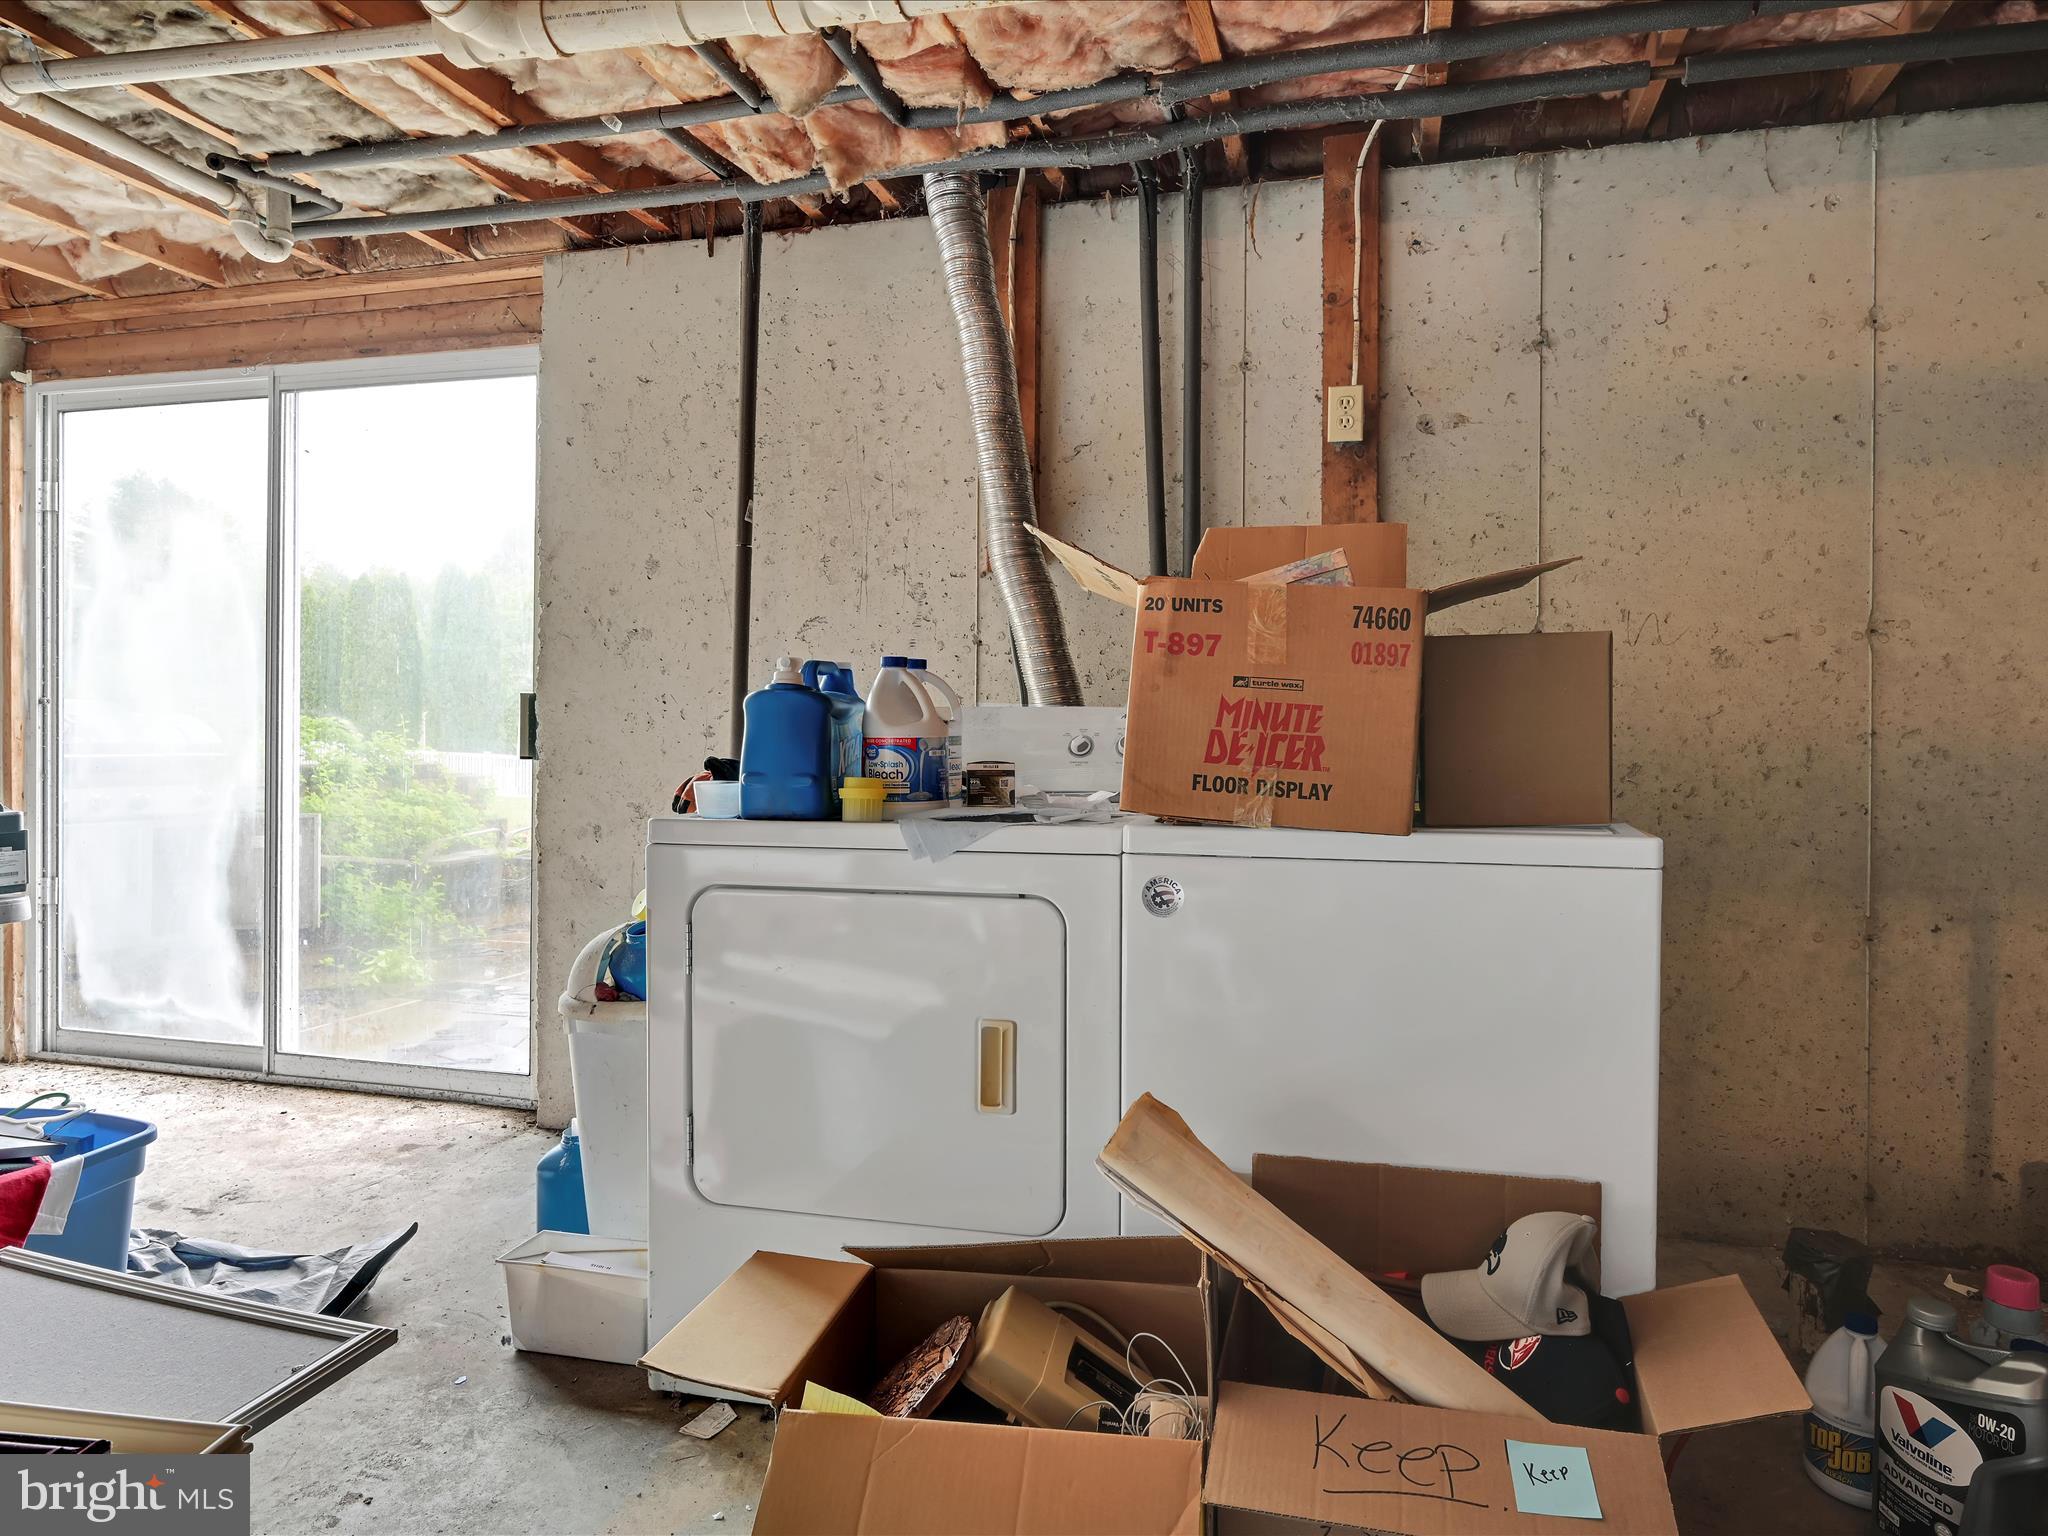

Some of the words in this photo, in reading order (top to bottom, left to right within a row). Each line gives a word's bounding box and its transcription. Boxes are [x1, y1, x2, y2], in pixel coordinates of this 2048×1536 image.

[1144, 597, 1165, 611] 20
[1172, 597, 1224, 613] UNITS
[1352, 605, 1412, 631] 74660
[1143, 630, 1222, 656] T-897
[1351, 641, 1412, 668] 01897
[1215, 693, 1325, 735] MINUTE
[868, 760, 903, 769] Low-Splash
[868, 769, 904, 780] Bleach
[1192, 773, 1249, 795] FLOOR
[1256, 779, 1333, 801] DISPLAY
[1145, 877, 1181, 895] AMERICA
[1809, 1422, 1842, 1452] TOP
[1968, 1422, 1999, 1448] MOTOR
[2000, 1438, 2016, 1455] OIL
[1978, 1413, 2016, 1442] 0W-20
[1827, 1447, 1872, 1474] JOB
[1891, 1428, 1953, 1477] Valvoline
[1522, 1462, 1568, 1486] Keep
[1883, 1461, 1954, 1516] ADVANCED
